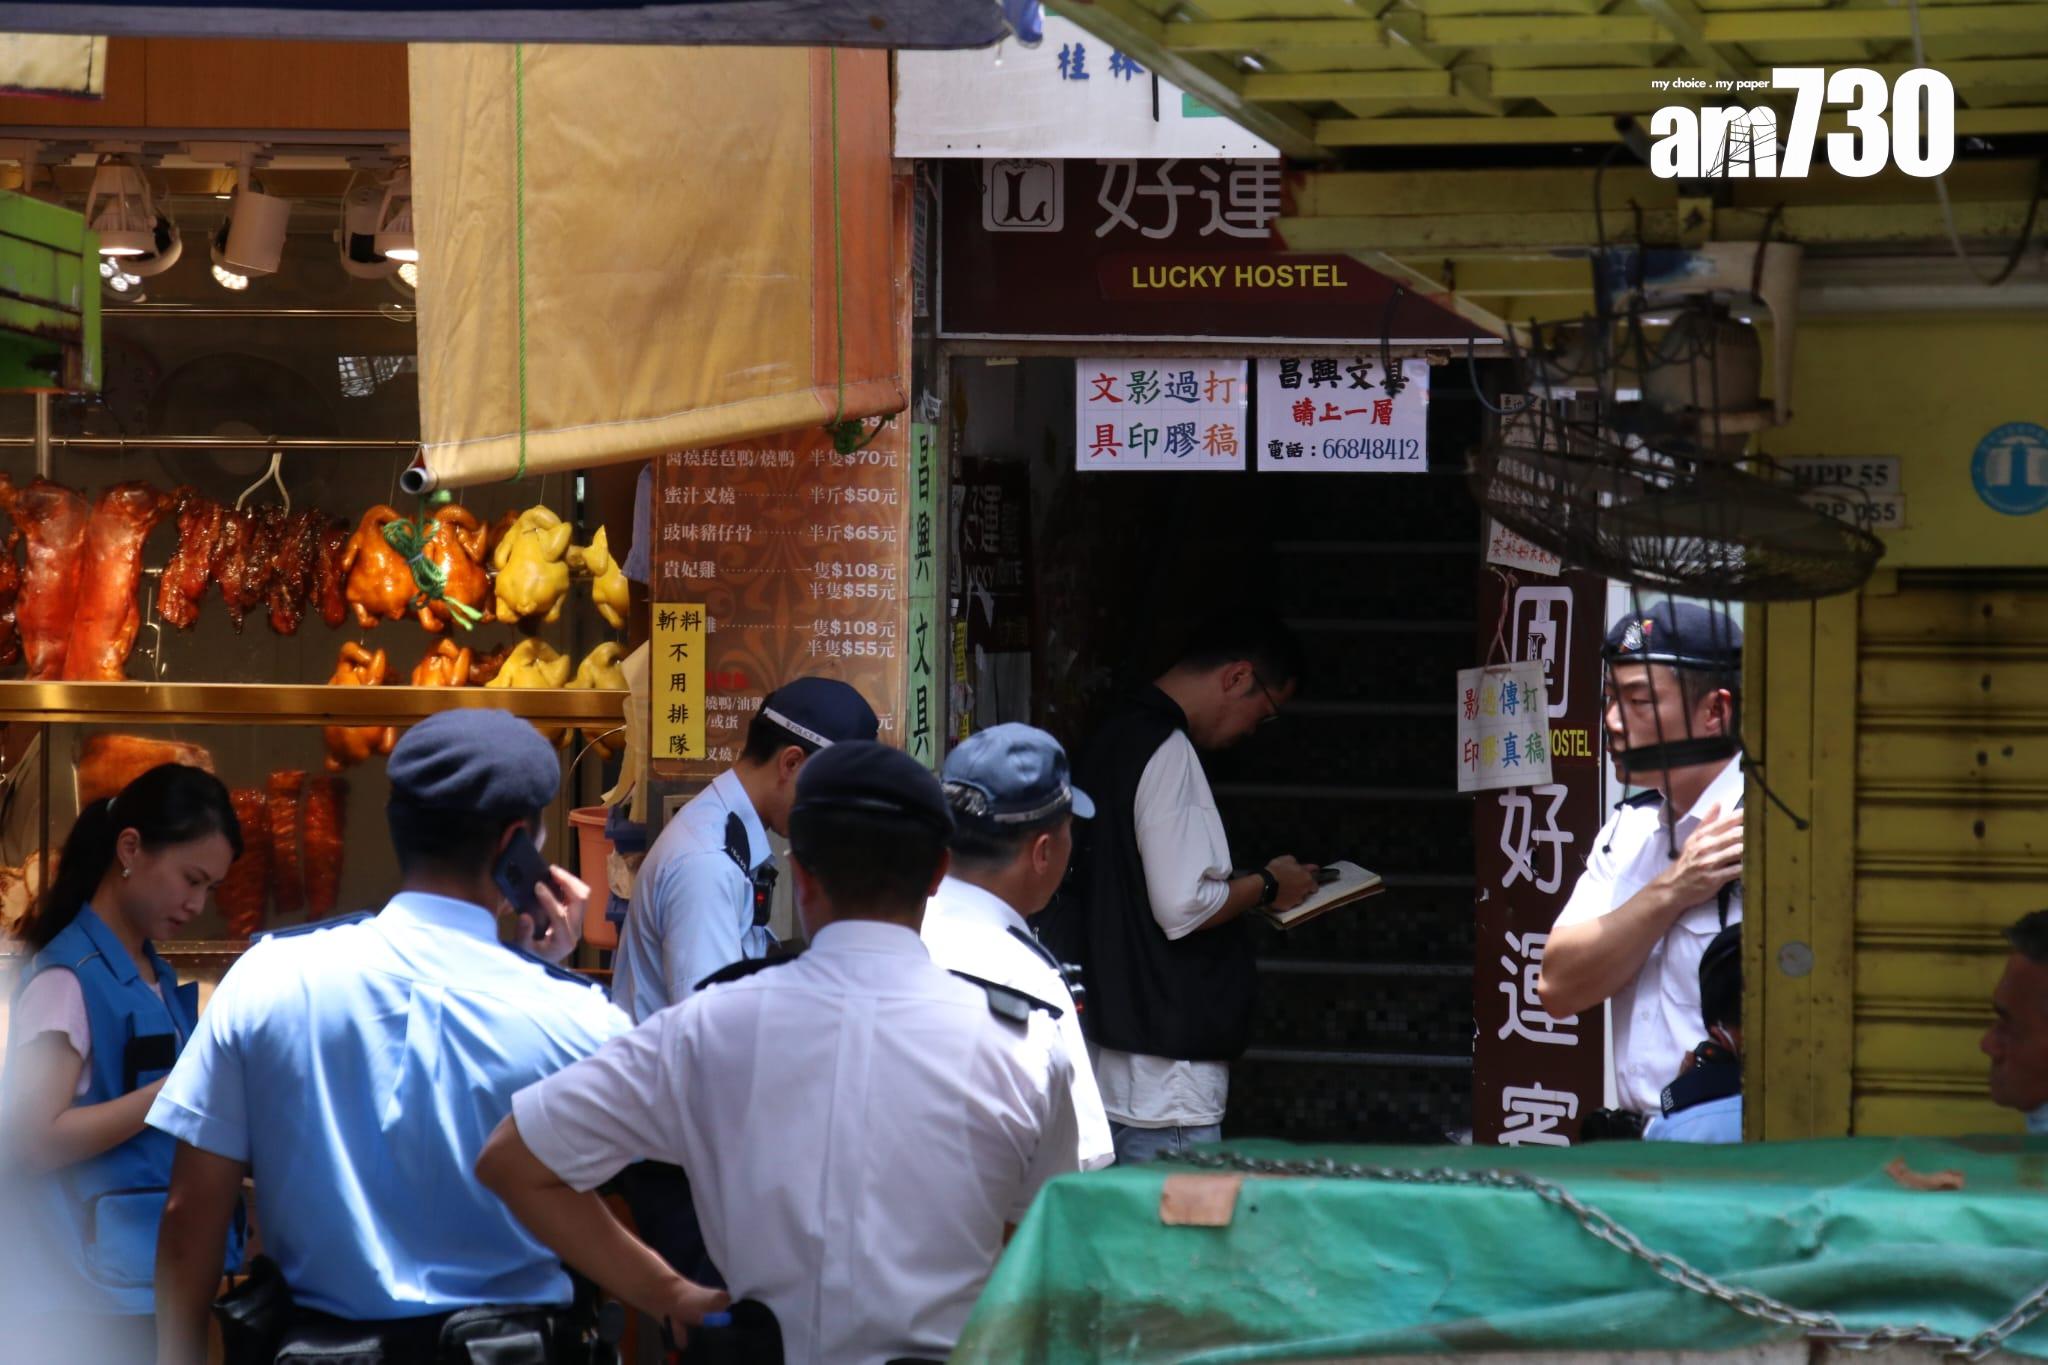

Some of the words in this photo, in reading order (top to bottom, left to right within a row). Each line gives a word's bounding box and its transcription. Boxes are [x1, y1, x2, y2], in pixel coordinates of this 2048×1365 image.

[1095, 158, 1280, 239] 好運
[1132, 265, 1226, 288] LUCKY
[1235, 264, 1348, 287] HOSTEL
[1292, 398, 1393, 428] 請上一層
[1323, 438, 1420, 461] 66848412
[1857, 464, 1889, 487] 55
[664, 486, 736, 505] 蜜汁叉燒
[667, 643, 690, 756] 不用排隊
[1551, 729, 1591, 758] OSTEL
